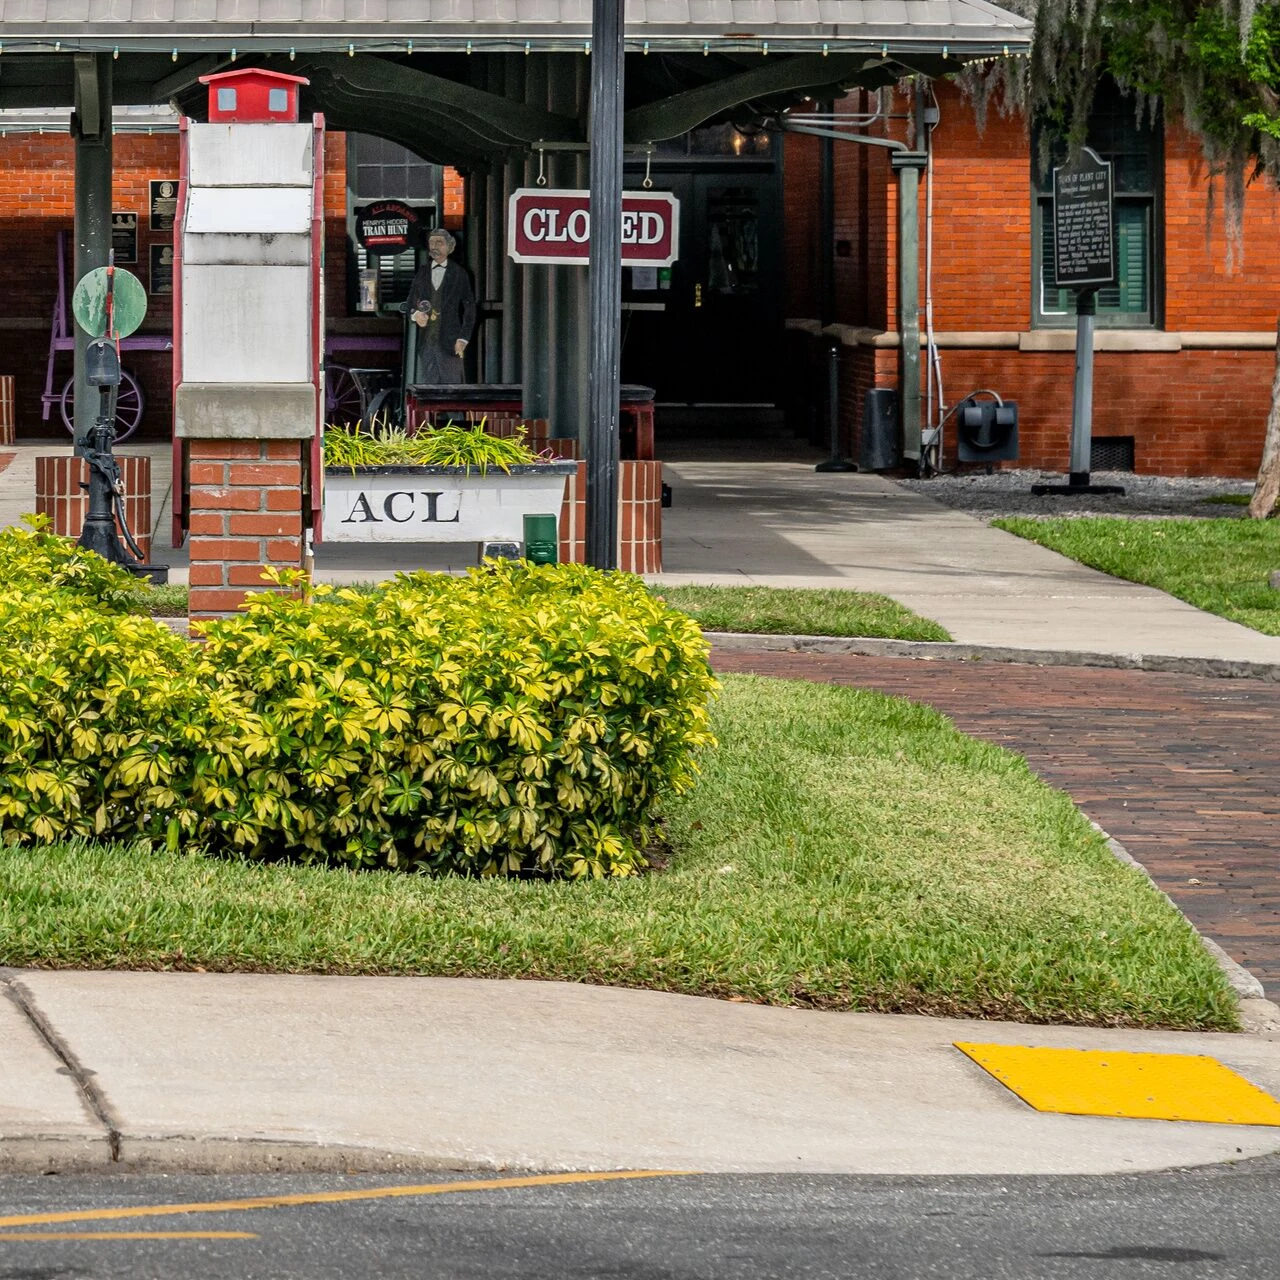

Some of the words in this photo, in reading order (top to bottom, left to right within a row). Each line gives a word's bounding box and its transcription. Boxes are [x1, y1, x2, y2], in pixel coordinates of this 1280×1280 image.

[1095, 171, 1107, 180] CITY
[387, 218, 408, 226] HIDDEN
[523, 208, 665, 244] CLOED
[362, 225, 387, 236] TRAIN
[387, 224, 408, 235] HUNT
[341, 491, 460, 523] ACL
